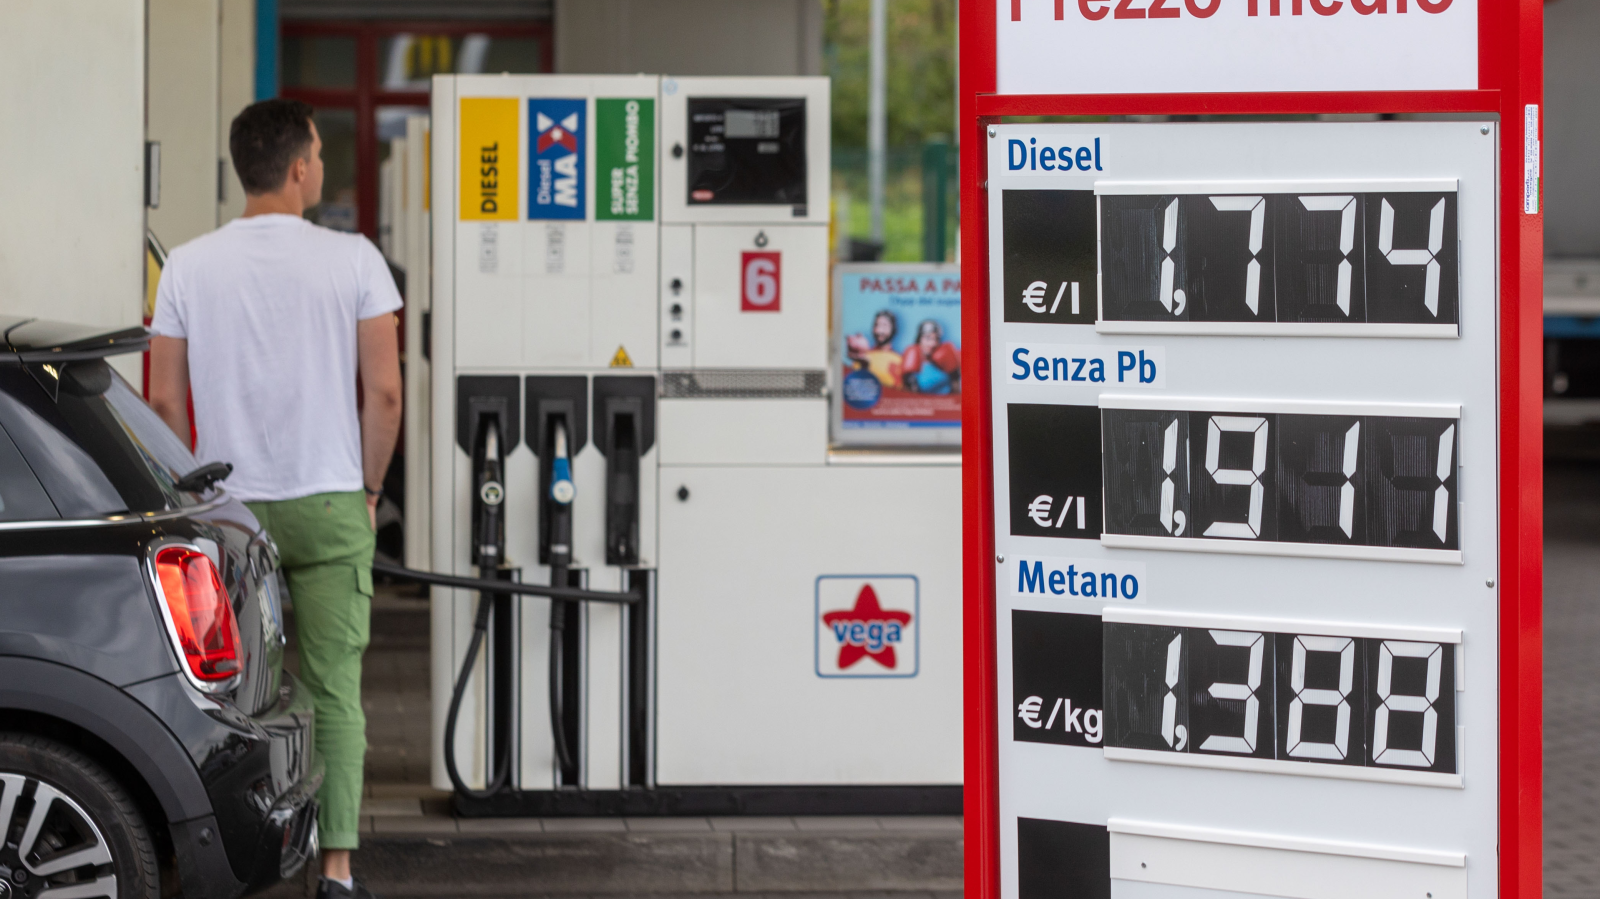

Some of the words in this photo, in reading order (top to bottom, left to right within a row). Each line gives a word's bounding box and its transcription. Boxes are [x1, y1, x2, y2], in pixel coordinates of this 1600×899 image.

[625, 99, 640, 163] PIOMBO
[1007, 137, 1103, 172] Diesel
[481, 142, 498, 214] DIESEL
[537, 159, 551, 205] Diesel
[611, 167, 625, 215] SUPER
[625, 164, 640, 215] SENZA
[1159, 195, 1446, 318] 1,774
[744, 257, 778, 307] 6
[860, 278, 919, 293] PASSA
[924, 278, 937, 292] A
[1011, 347, 1106, 383] Senza
[1117, 349, 1157, 384] Pb
[1160, 415, 1455, 543] 1,911
[1017, 560, 1139, 600] Metano
[834, 623, 902, 649] vega
[1018, 695, 1104, 744] €/kg
[1160, 630, 1443, 768] 1,388
